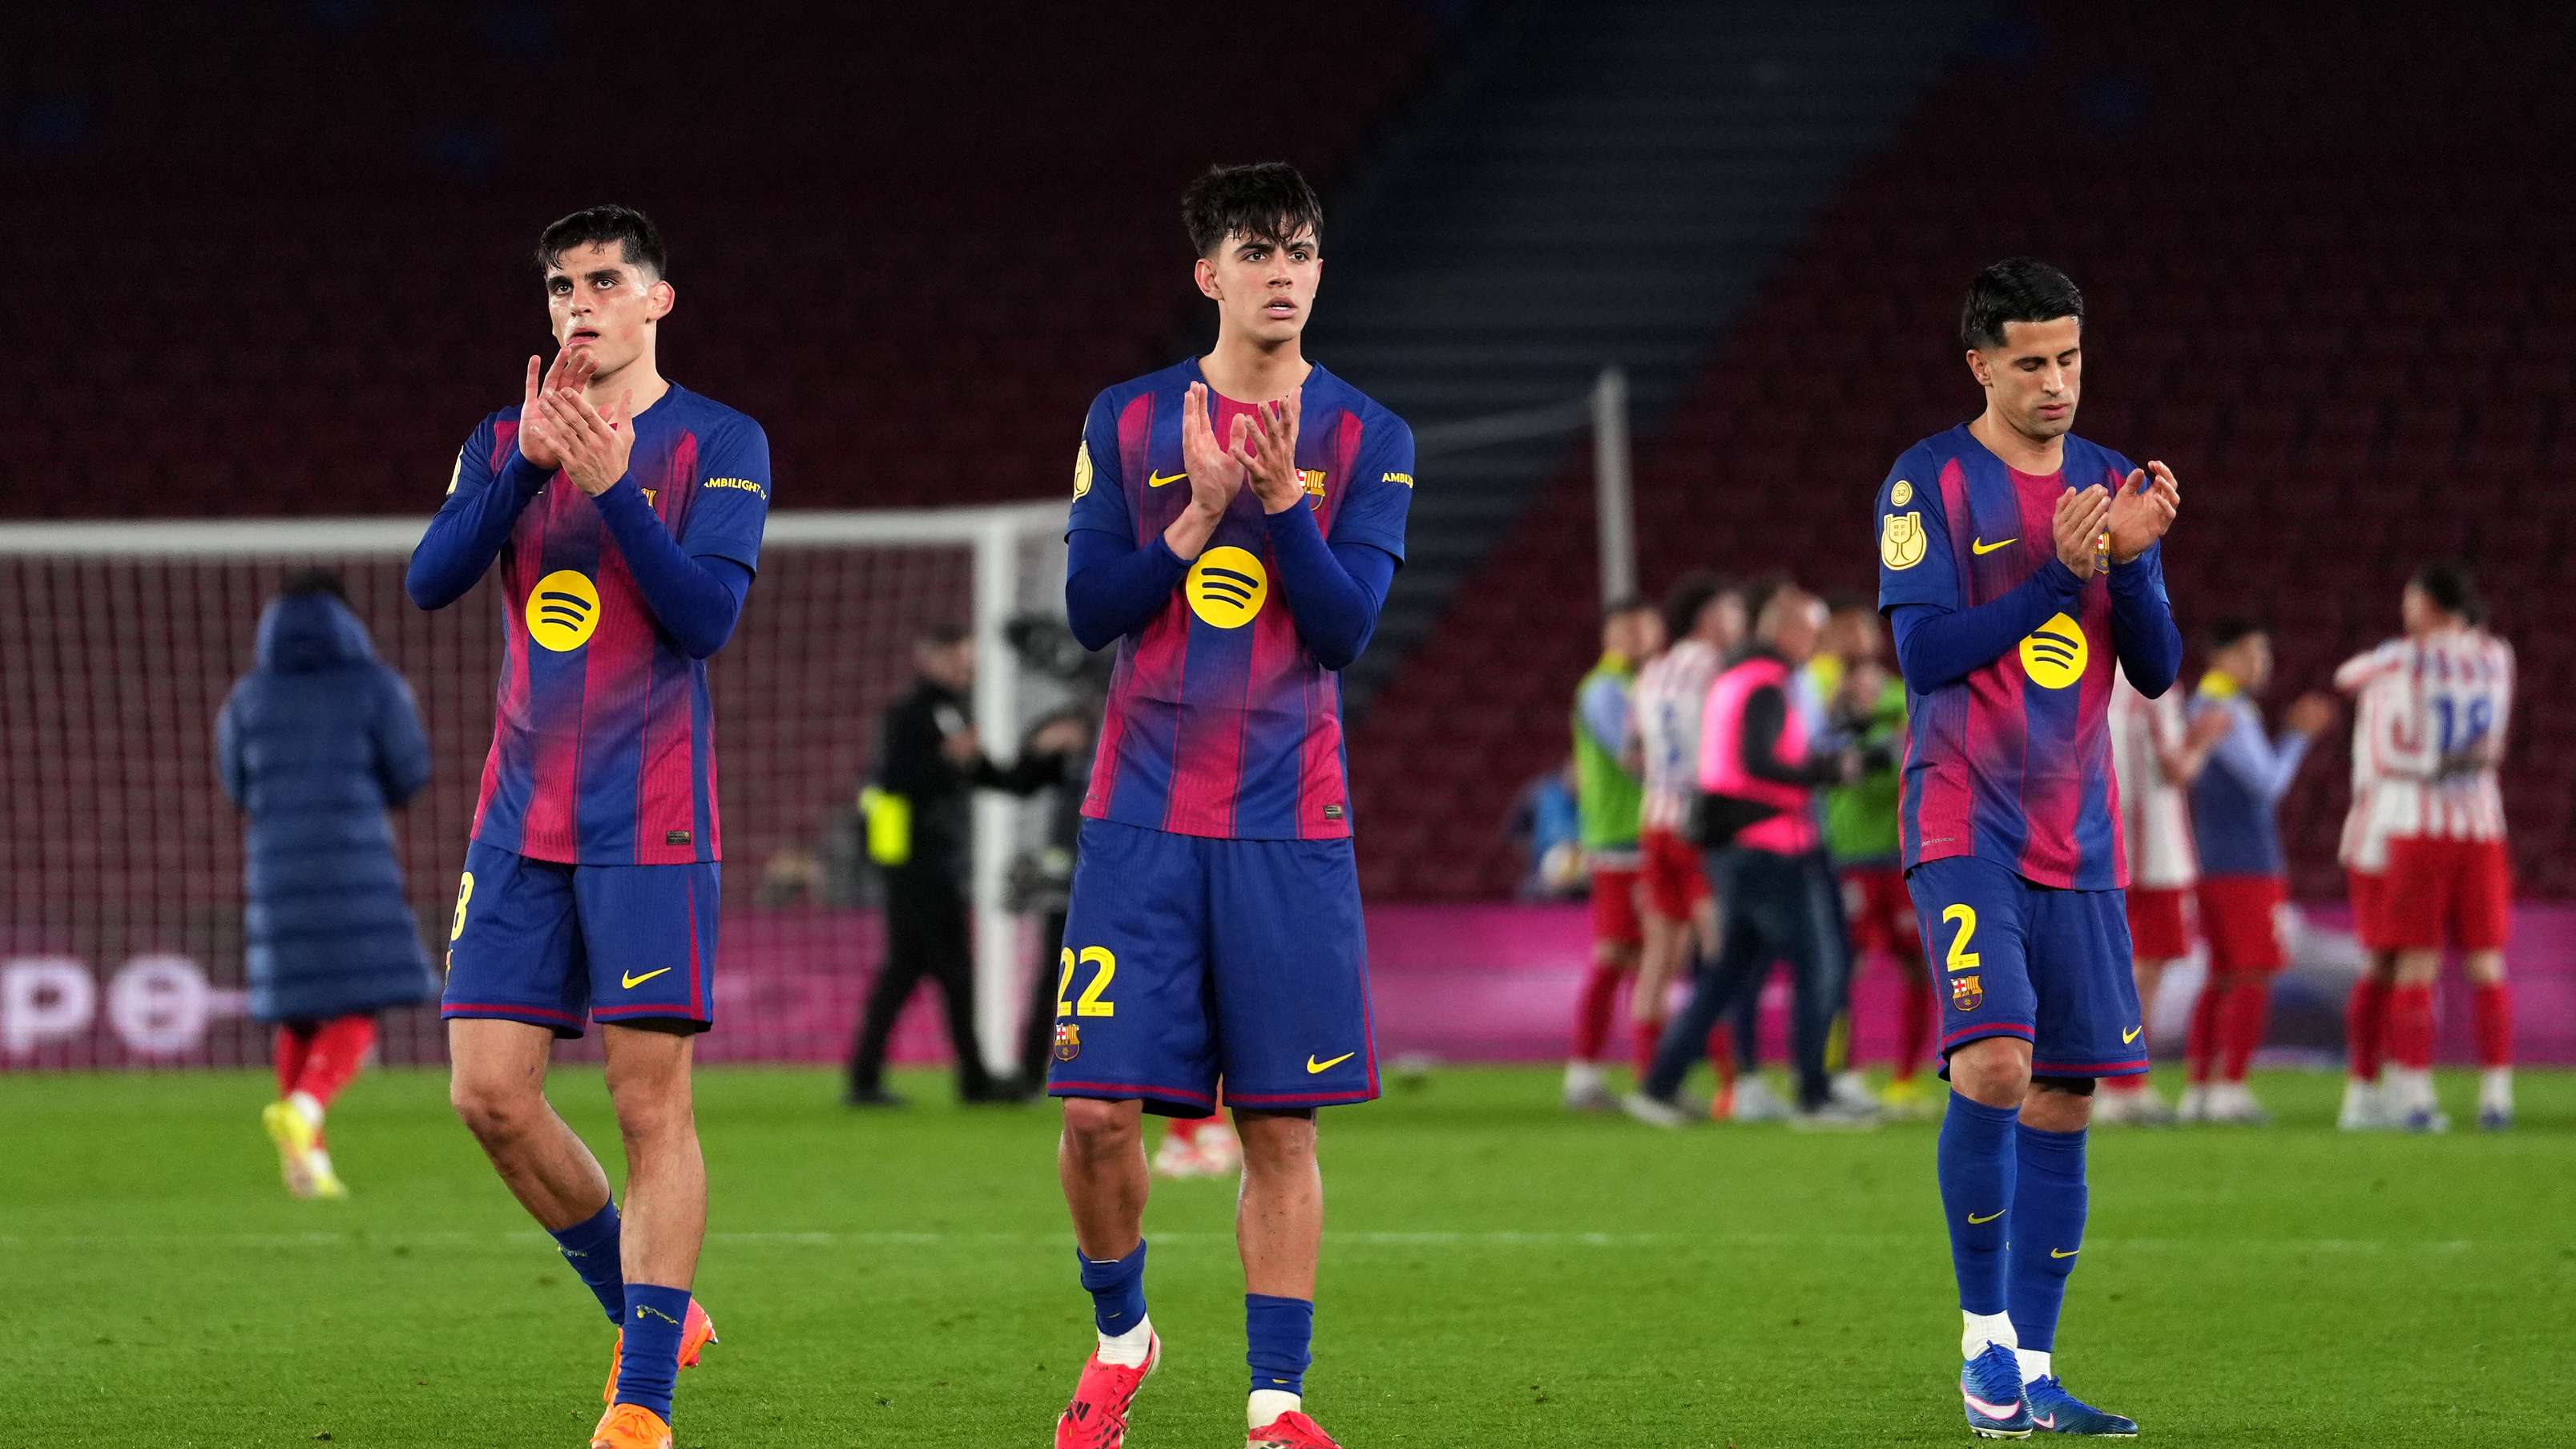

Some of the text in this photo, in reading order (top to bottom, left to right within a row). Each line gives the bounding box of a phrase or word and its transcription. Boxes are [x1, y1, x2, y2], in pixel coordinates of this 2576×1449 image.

[703, 478, 761, 494] AMBILIGHT
[1896, 489, 1906, 497] 32
[1942, 903, 1980, 972] 2
[1057, 946, 1116, 1017] 22
